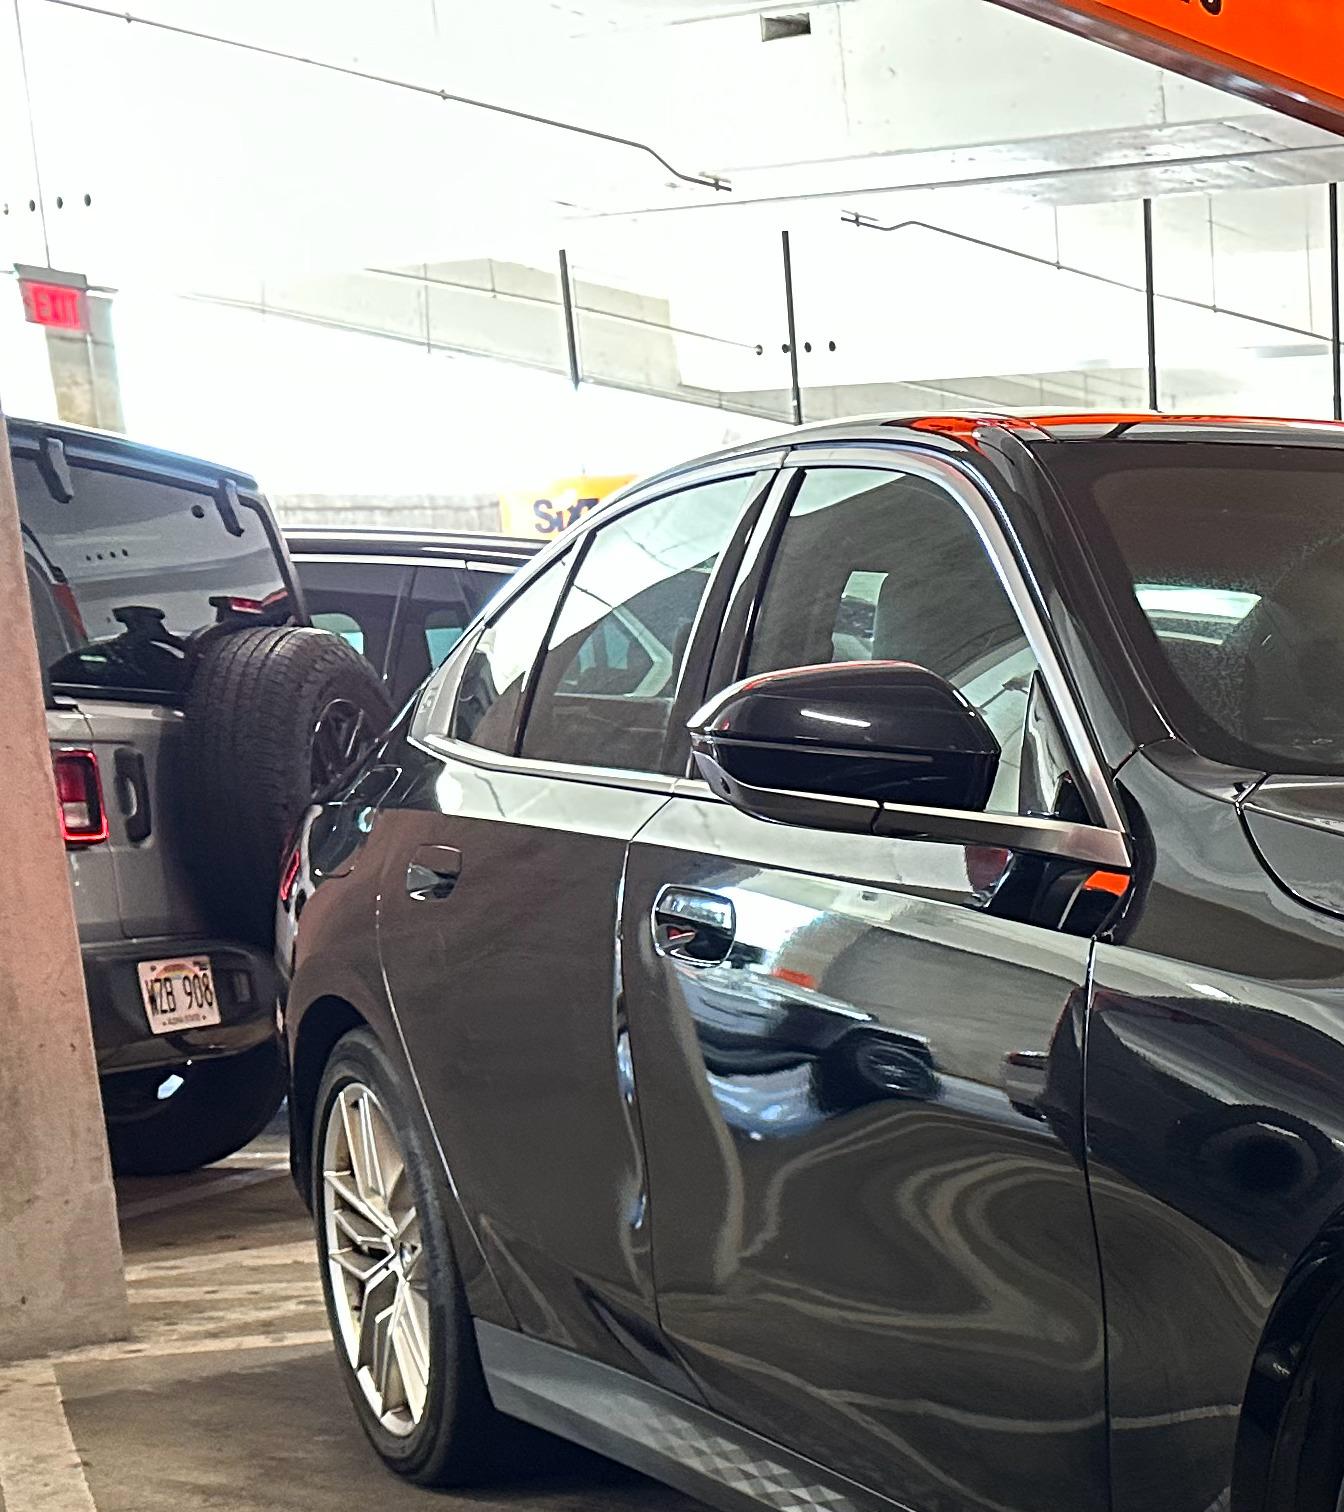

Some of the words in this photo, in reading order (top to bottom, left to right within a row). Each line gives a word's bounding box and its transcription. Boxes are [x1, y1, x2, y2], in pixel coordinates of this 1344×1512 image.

[32, 286, 79, 325] EXIT
[144, 978, 176, 1016] WZB
[183, 973, 213, 1008] 908
